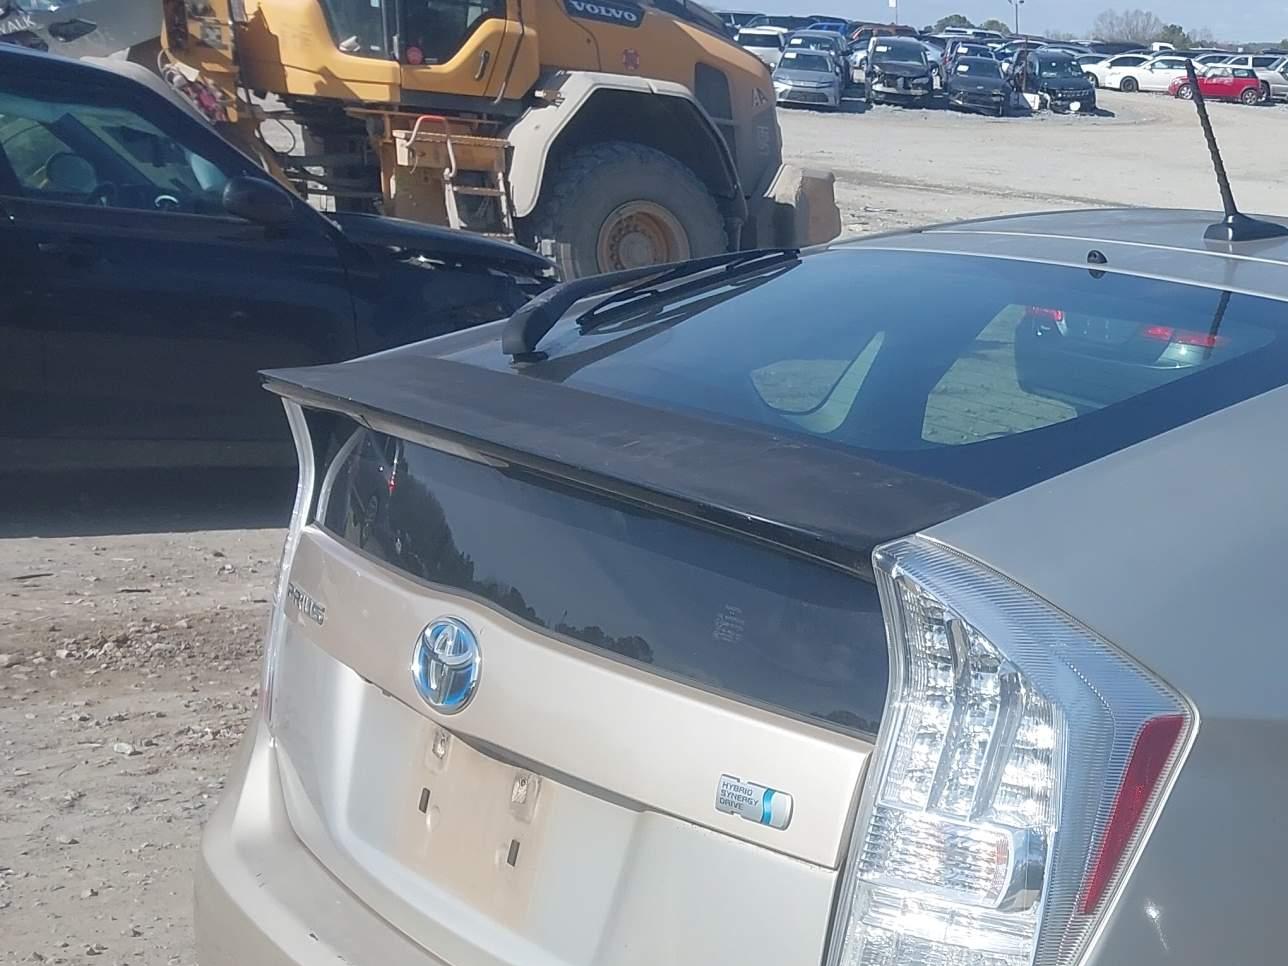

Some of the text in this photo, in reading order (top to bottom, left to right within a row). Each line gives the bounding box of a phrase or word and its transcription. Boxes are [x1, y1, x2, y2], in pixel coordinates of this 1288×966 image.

[569, 0, 637, 21] VOLVO
[288, 582, 325, 625] PRIUS
[722, 781, 753, 796] HYBRID
[719, 797, 744, 811] DRIVE
[720, 789, 759, 806] SYNERGY
